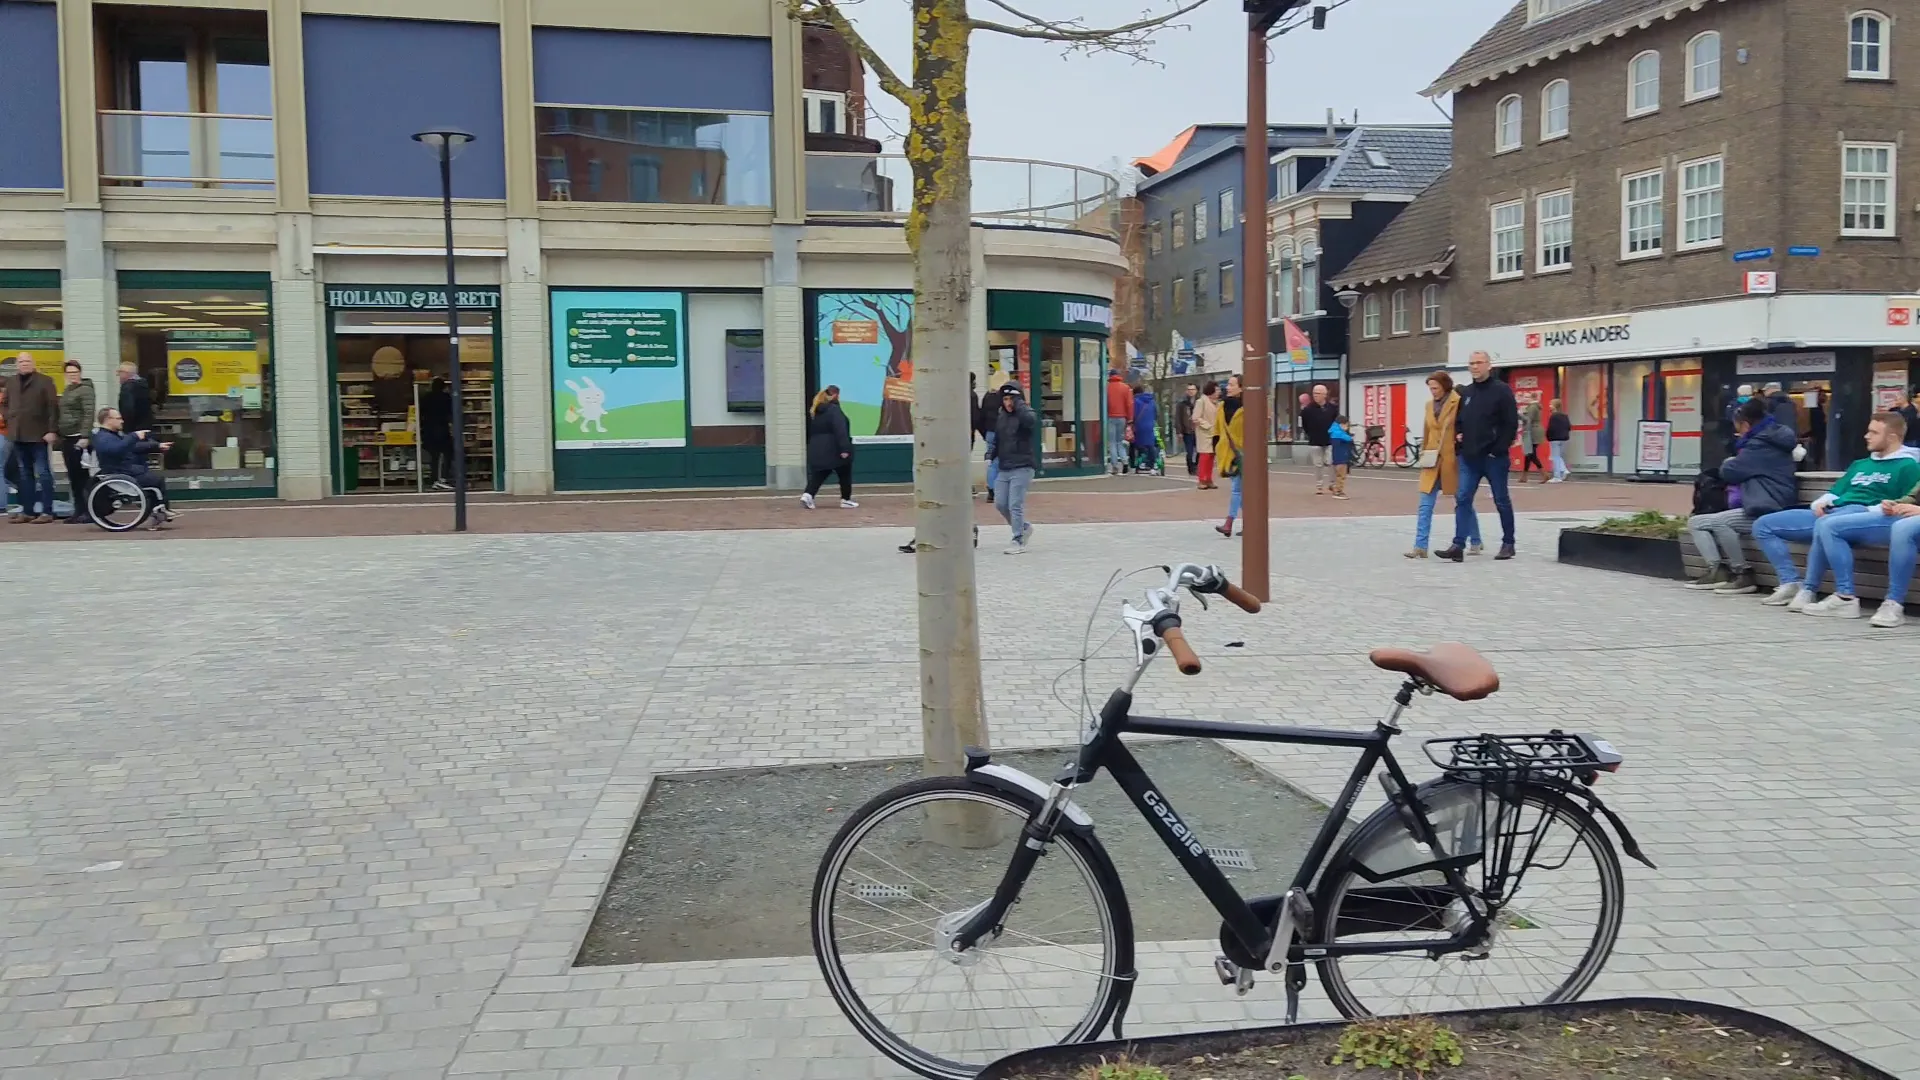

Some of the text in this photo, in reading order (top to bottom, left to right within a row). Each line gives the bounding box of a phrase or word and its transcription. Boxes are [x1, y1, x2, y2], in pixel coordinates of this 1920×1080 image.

[328, 290, 500, 308] HOLLAND & BARETT
[1544, 324, 1631, 347] HANS ANDERS
[1758, 356, 1831, 368] HANS ANDERS
[1142, 790, 1204, 857] Gazelle
